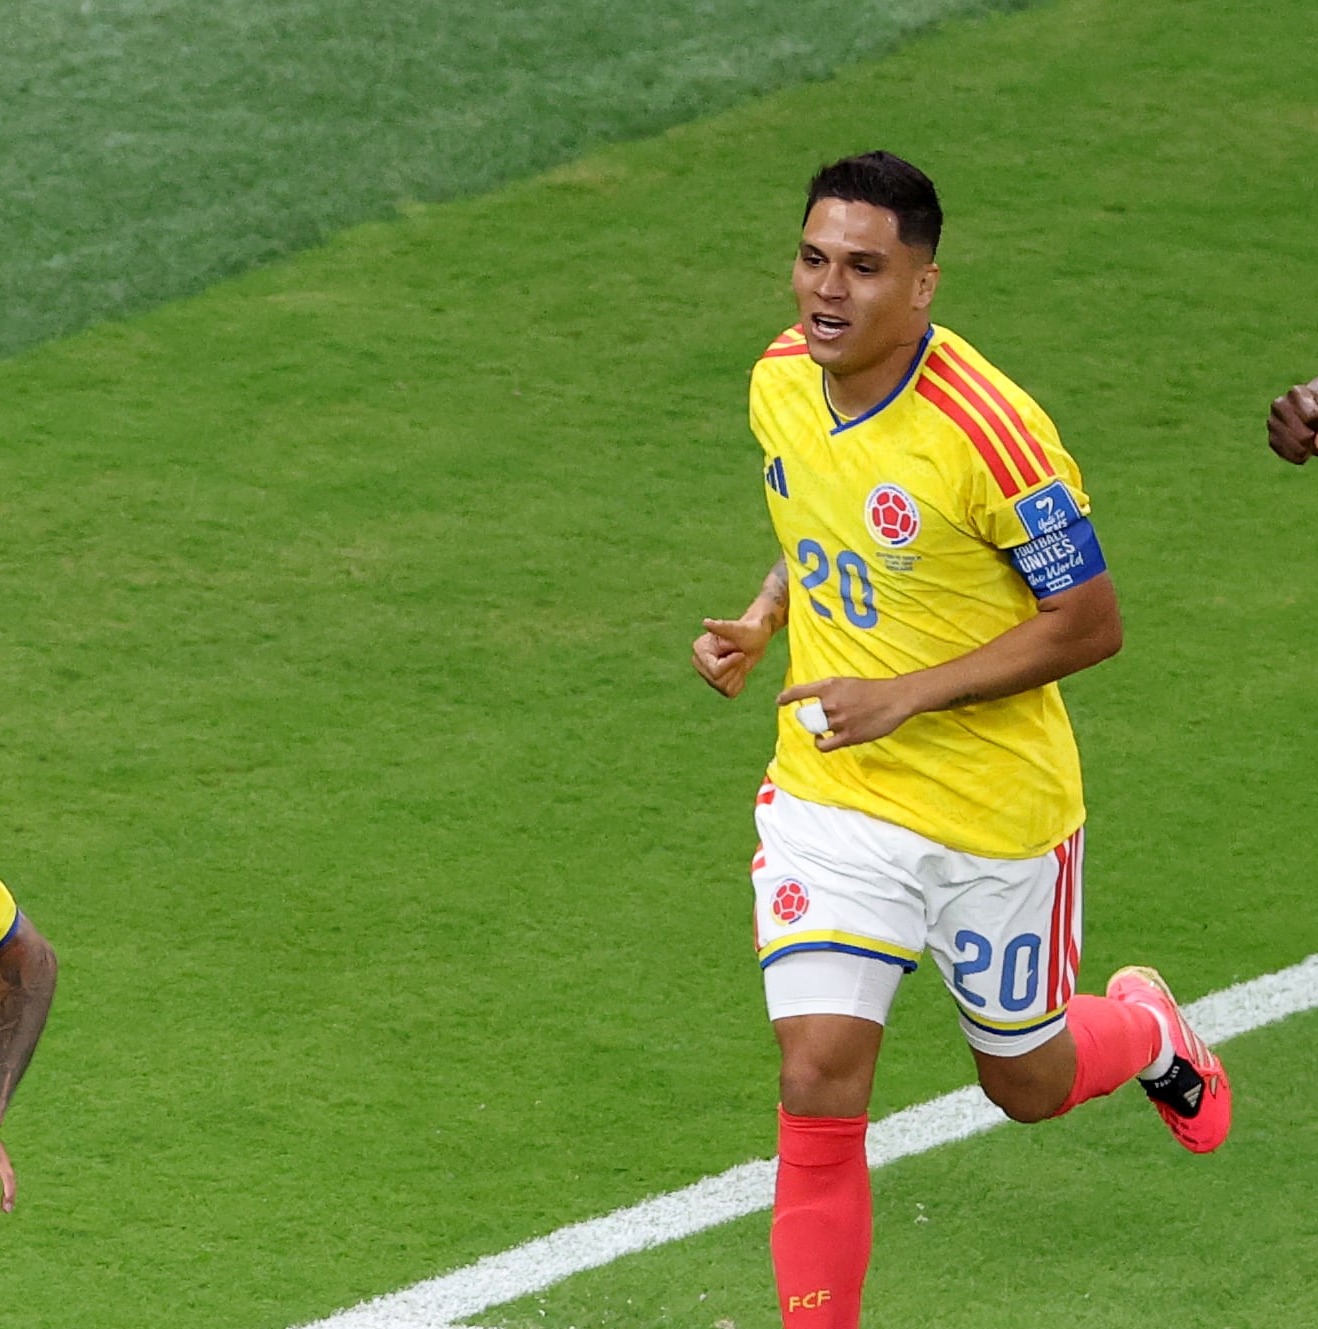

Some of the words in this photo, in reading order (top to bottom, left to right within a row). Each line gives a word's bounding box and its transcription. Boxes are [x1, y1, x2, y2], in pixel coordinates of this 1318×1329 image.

[1014, 529, 1068, 559] FOOTBALL
[1019, 538, 1076, 574] UNITES
[797, 537, 878, 629] 20
[1027, 573, 1046, 586] the
[1044, 552, 1084, 580] World
[952, 928, 1043, 1013] 20
[788, 1290, 831, 1312] FCF
